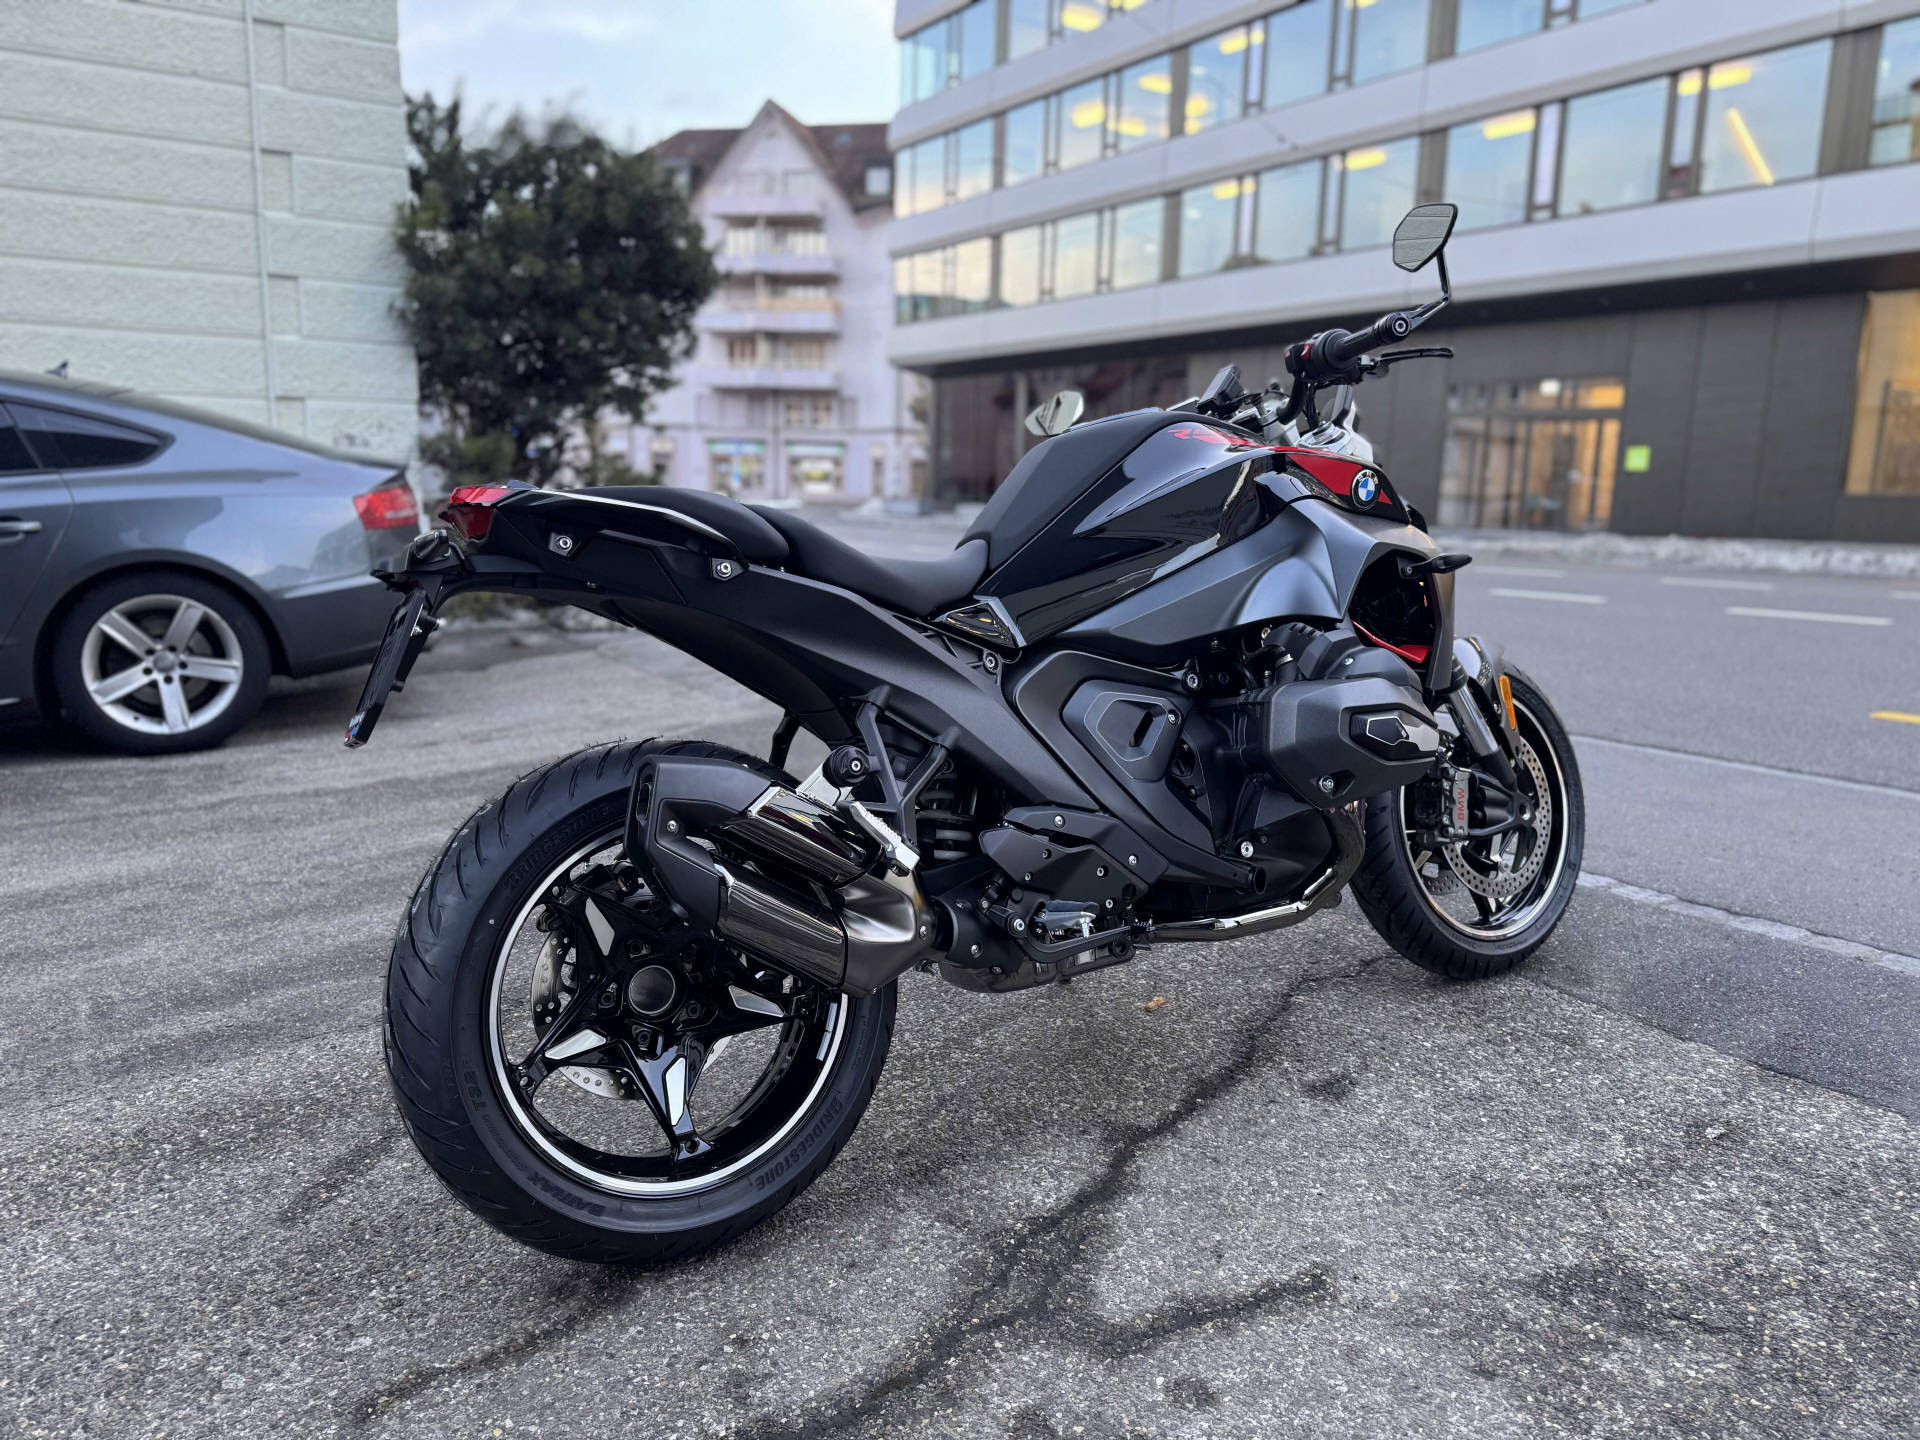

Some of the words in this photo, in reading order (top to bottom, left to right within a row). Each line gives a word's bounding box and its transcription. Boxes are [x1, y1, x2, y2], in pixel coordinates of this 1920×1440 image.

[1358, 470, 1379, 485] BMW
[1457, 787, 1466, 821] BMW
[755, 1095, 844, 1190] BRIDGESTONE
